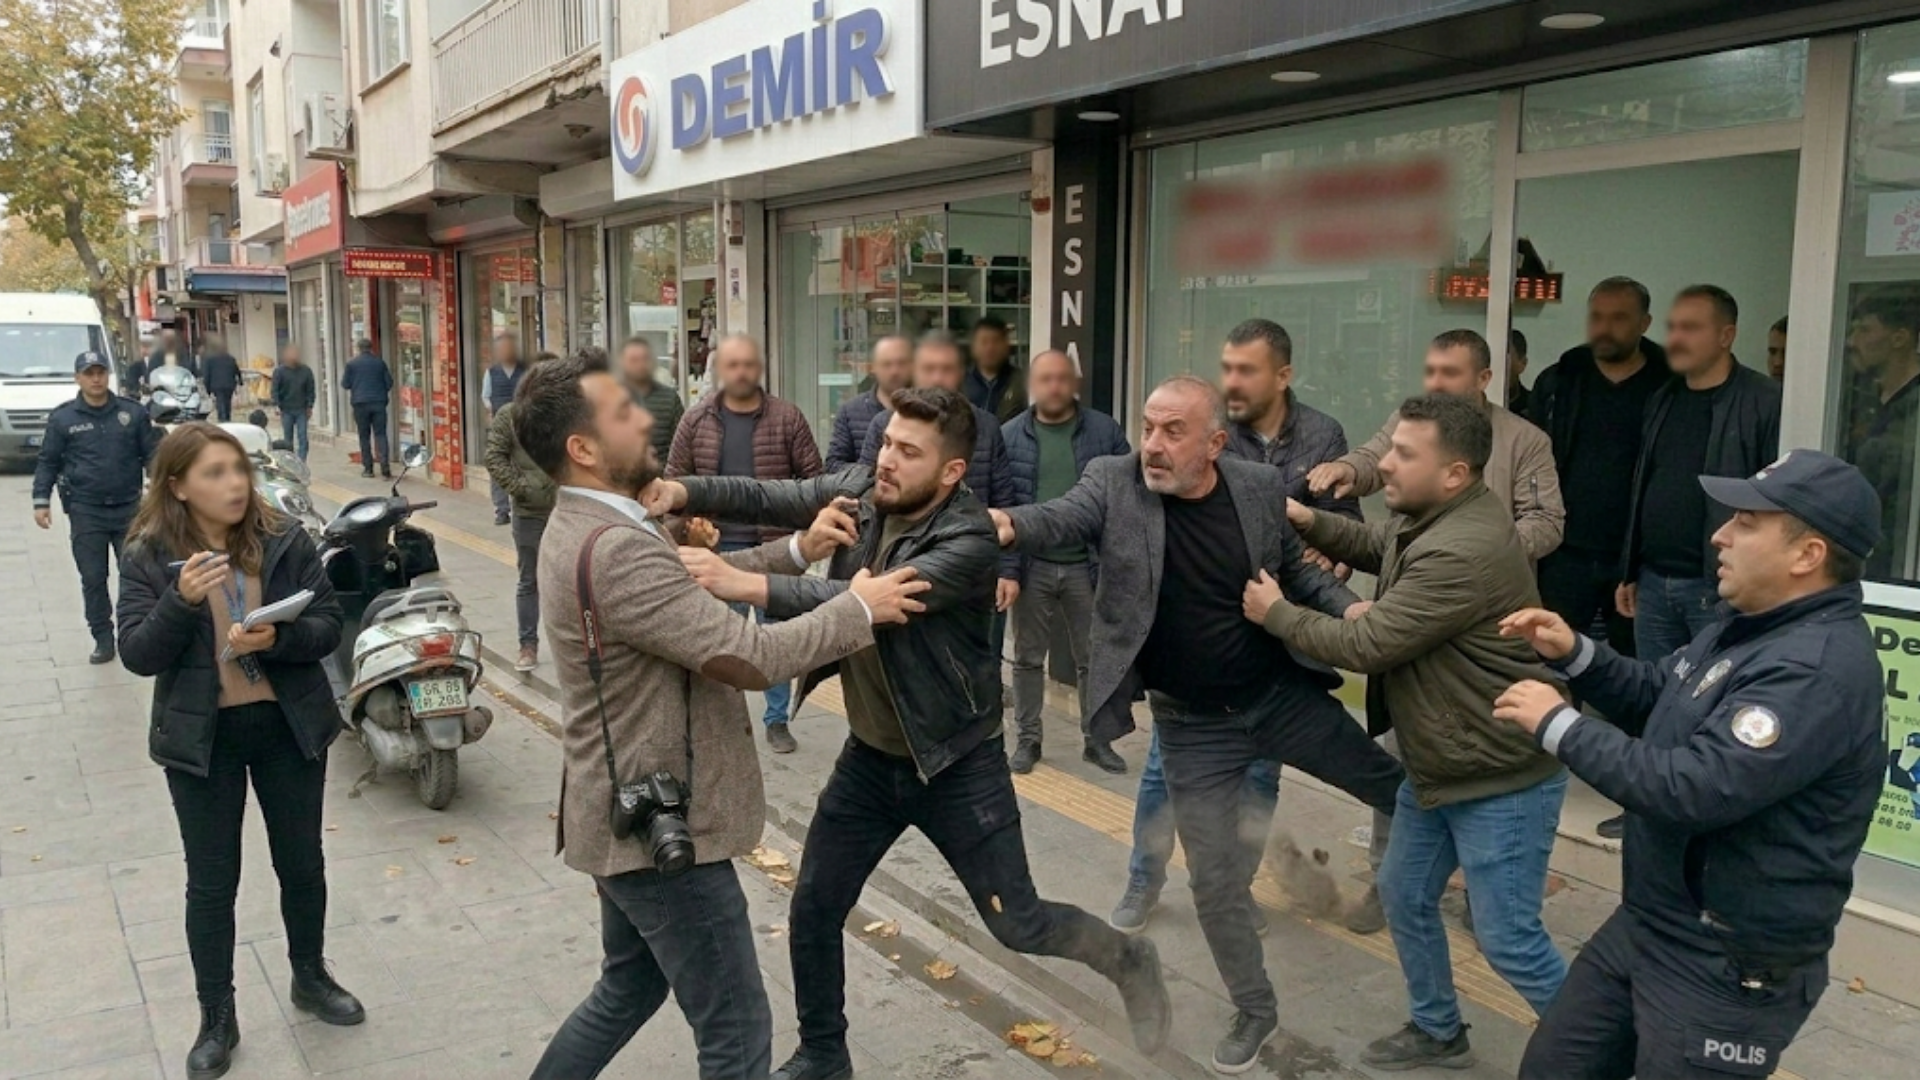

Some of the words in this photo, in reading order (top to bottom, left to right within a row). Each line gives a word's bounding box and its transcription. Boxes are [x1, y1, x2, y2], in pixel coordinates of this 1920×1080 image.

[671, 1, 892, 150] DEMİR
[980, 0, 1184, 69] ESN
[1061, 184, 1084, 401] ESNA
[1704, 1038, 1767, 1065] POLIS
